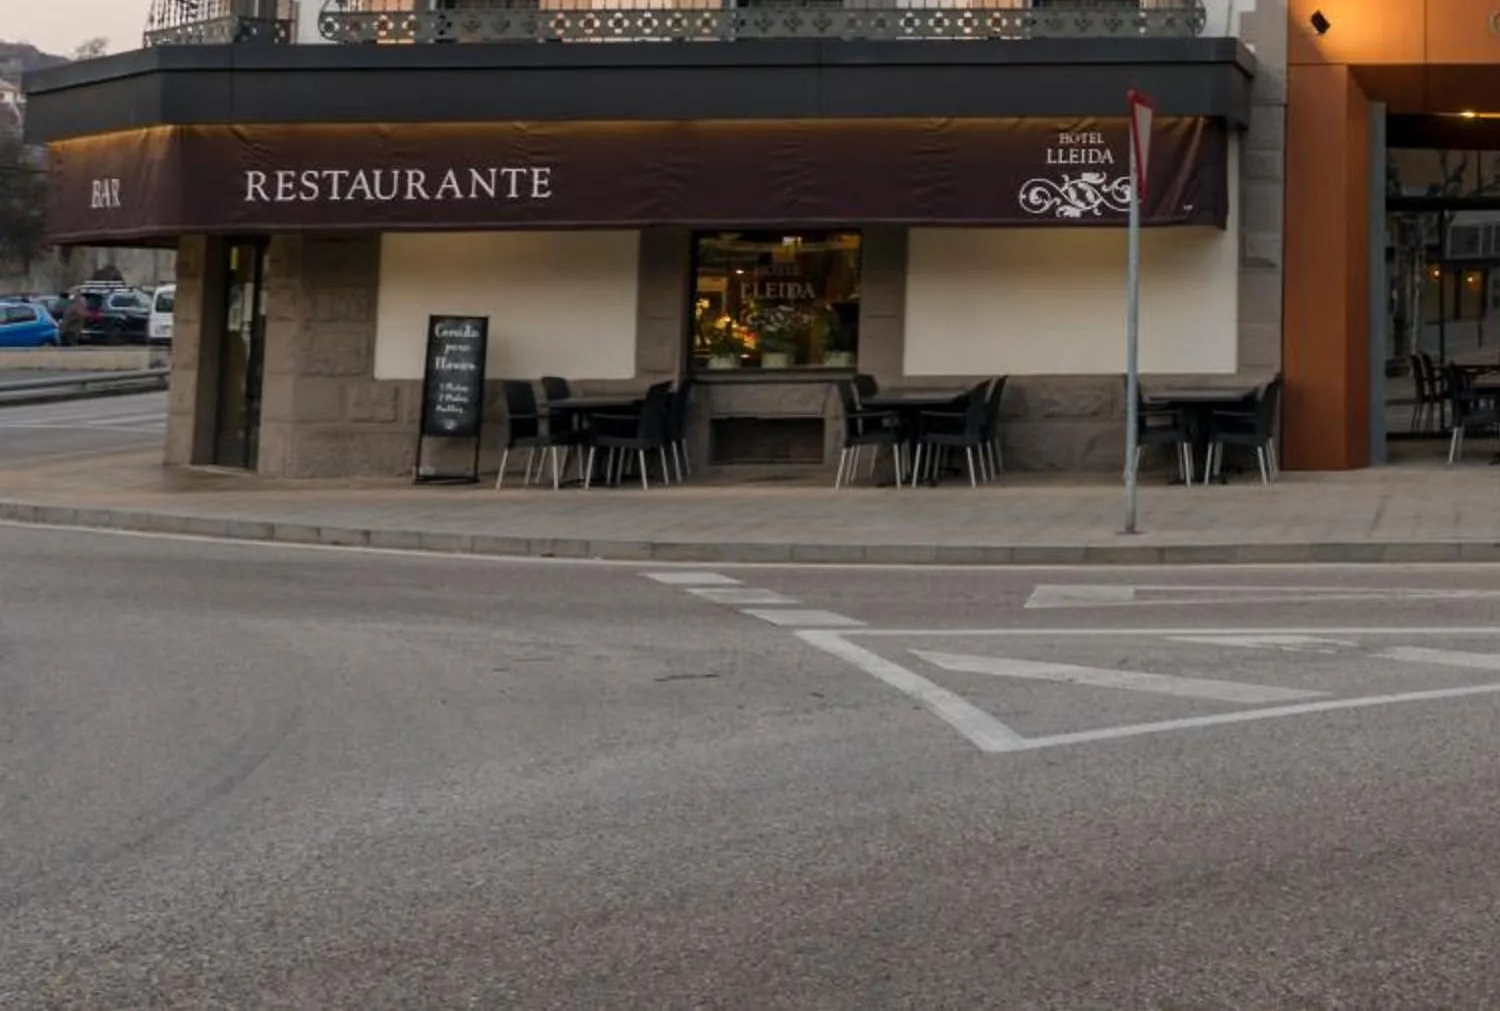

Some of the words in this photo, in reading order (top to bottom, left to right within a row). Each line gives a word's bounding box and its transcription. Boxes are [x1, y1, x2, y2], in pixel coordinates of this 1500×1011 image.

[1059, 132, 1105, 144] HOTEL
[1046, 148, 1114, 164] LLEIDA
[90, 178, 121, 209] BAR
[243, 167, 553, 203] RESTAURANTE
